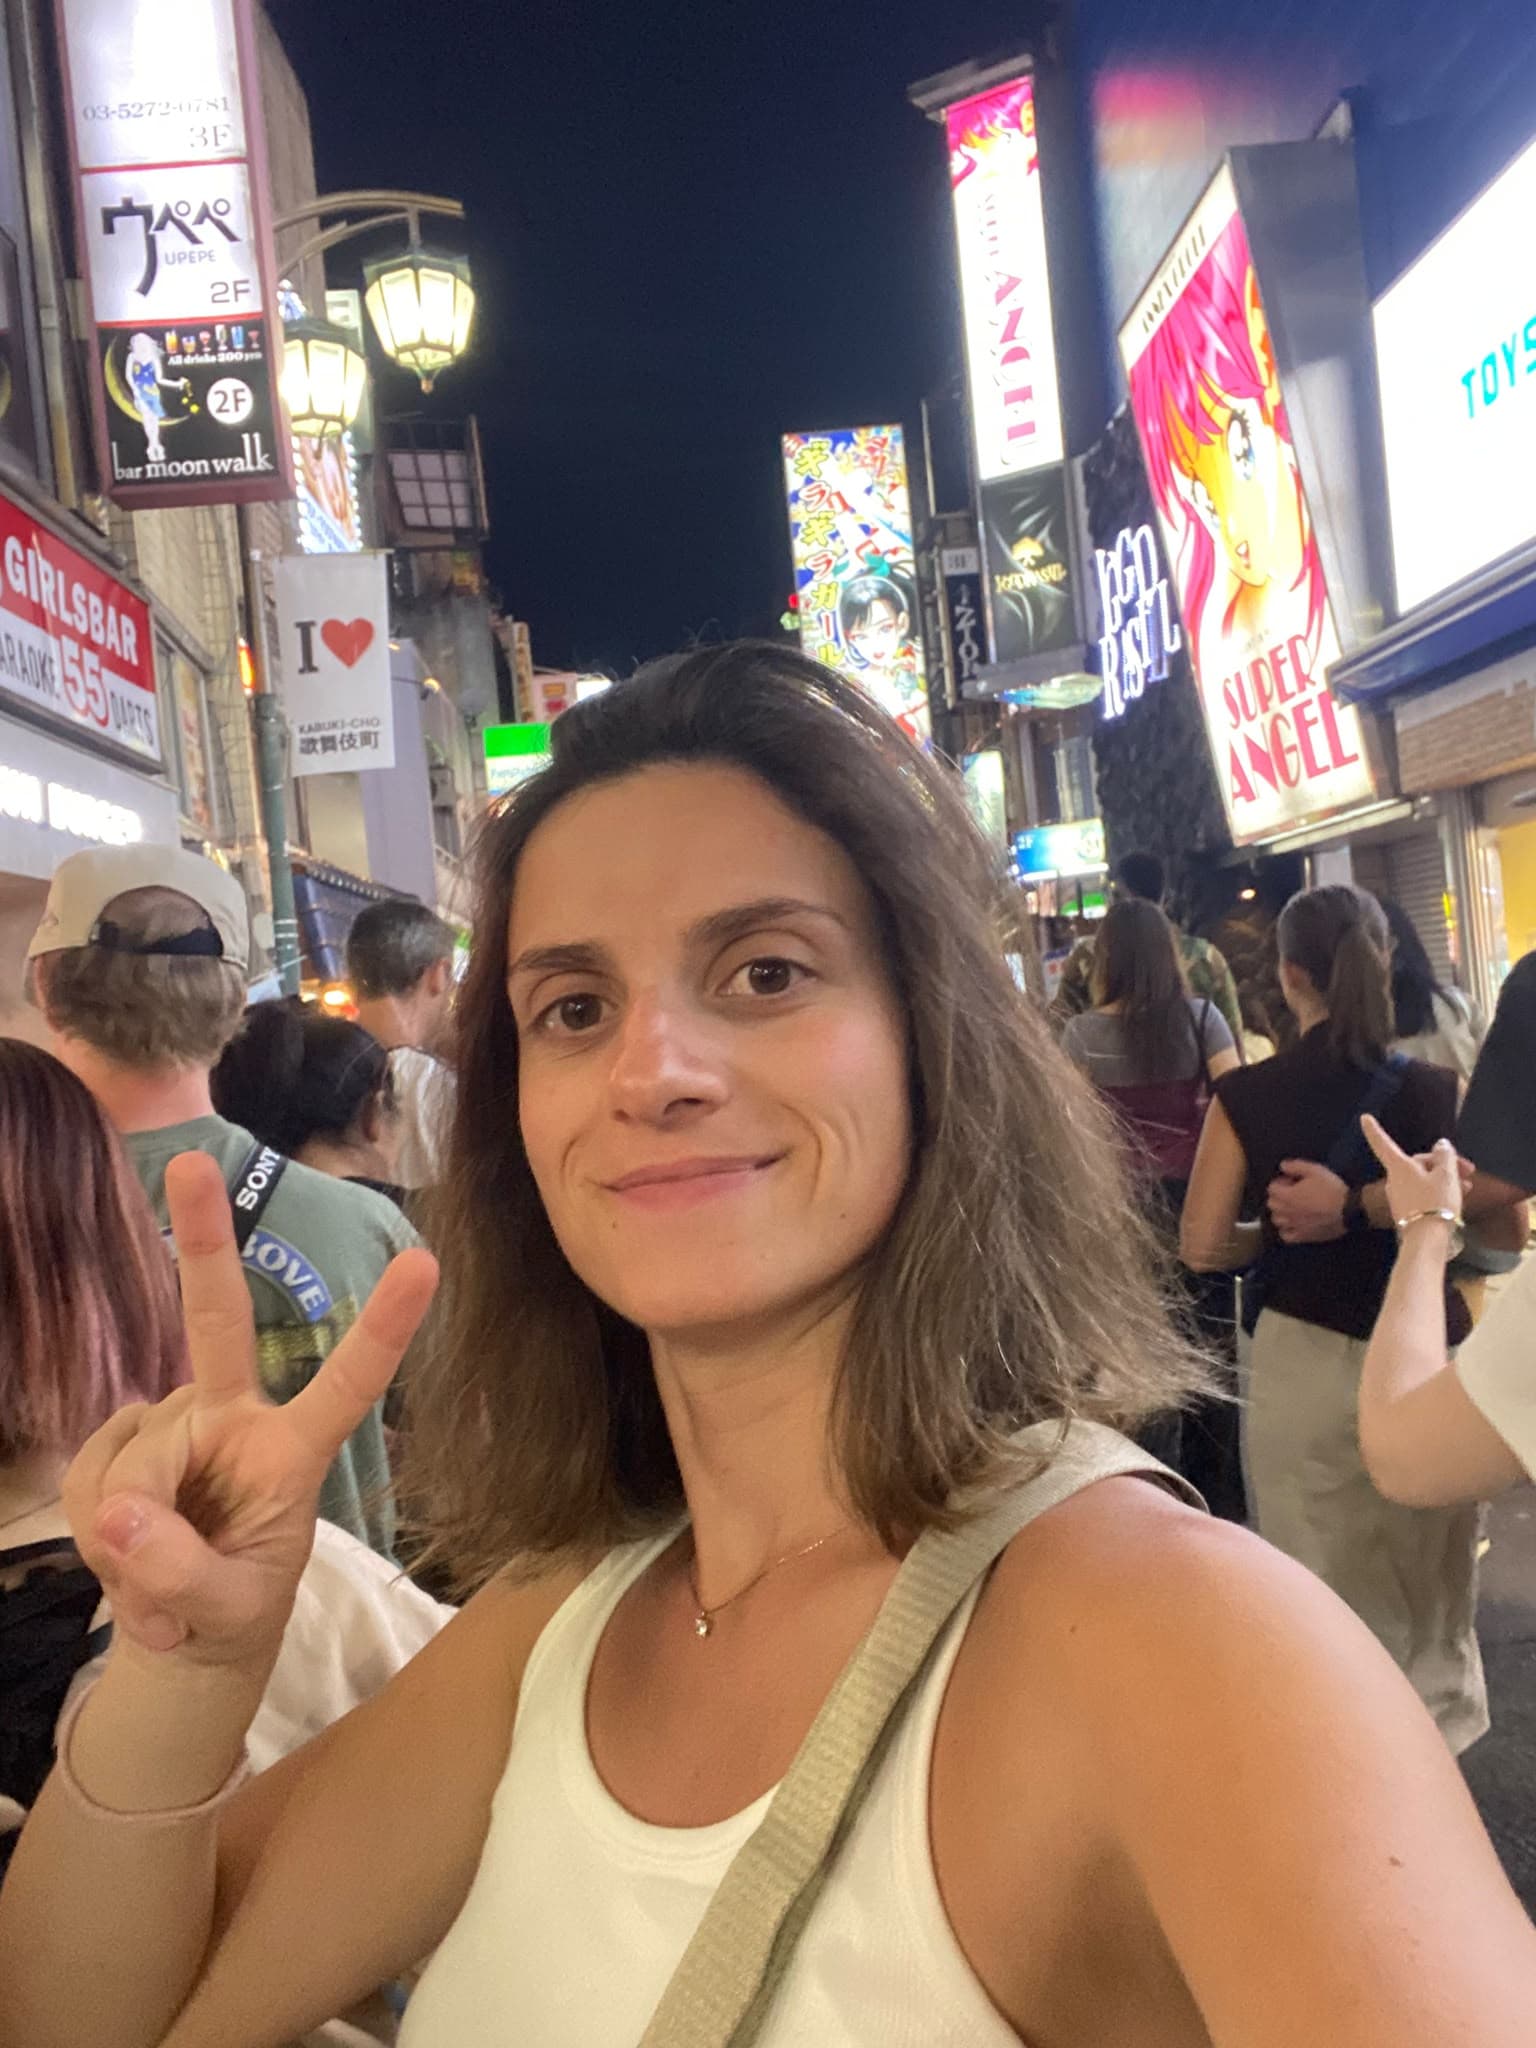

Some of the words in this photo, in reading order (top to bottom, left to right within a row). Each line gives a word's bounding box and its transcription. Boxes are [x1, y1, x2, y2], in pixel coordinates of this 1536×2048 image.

[190, 124, 231, 147] 3F
[164, 250, 216, 265] UPEPE
[210, 280, 250, 303] 2F
[214, 388, 246, 413] 2F
[112, 441, 142, 480] bar
[145, 460, 211, 478] moon
[212, 432, 274, 474] walk
[294, 620, 318, 674] I
[61, 634, 109, 728] 55
[1223, 634, 1317, 730] SUPER
[299, 716, 380, 735] KABUKI-CHO
[1229, 689, 1359, 809] ANGEL
[235, 1146, 280, 1211] SONY
